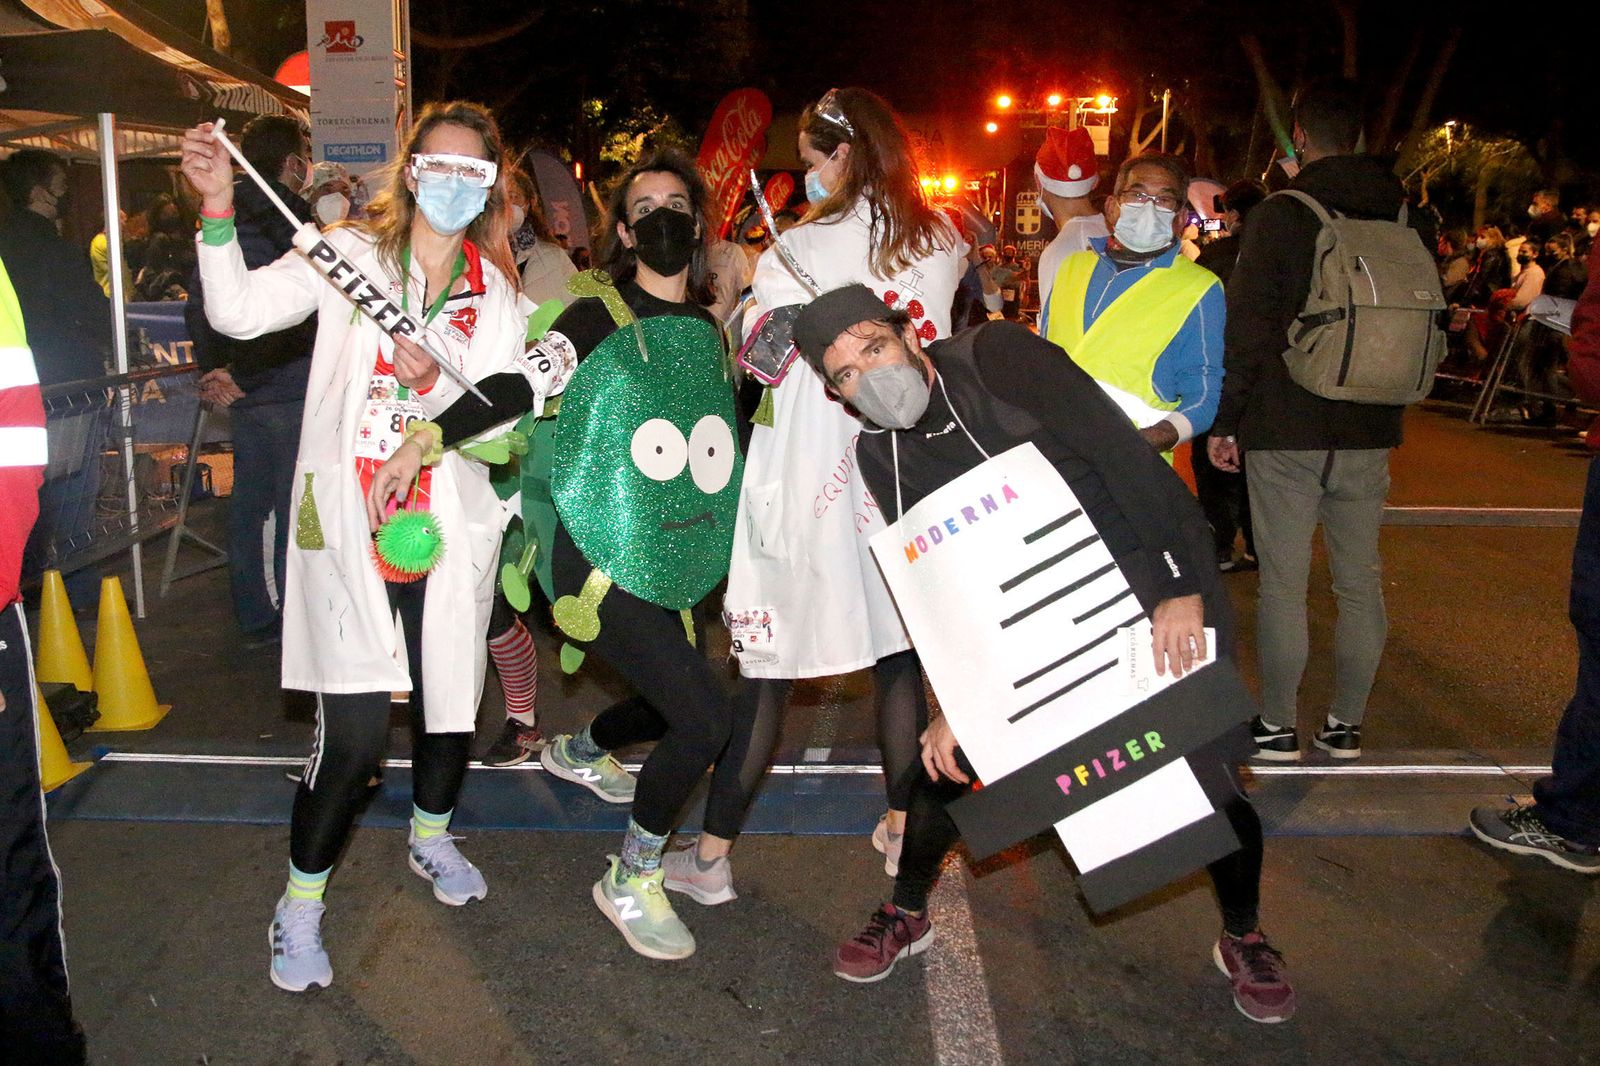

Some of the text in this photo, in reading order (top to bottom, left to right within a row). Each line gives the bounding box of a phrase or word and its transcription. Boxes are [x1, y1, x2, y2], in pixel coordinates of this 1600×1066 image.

[326, 145, 382, 156] DECATHLON
[697, 96, 761, 192] oca-Cola
[527, 348, 551, 373] 70
[904, 484, 1018, 564] MODERNA
[1055, 731, 1165, 795] PFIZER
